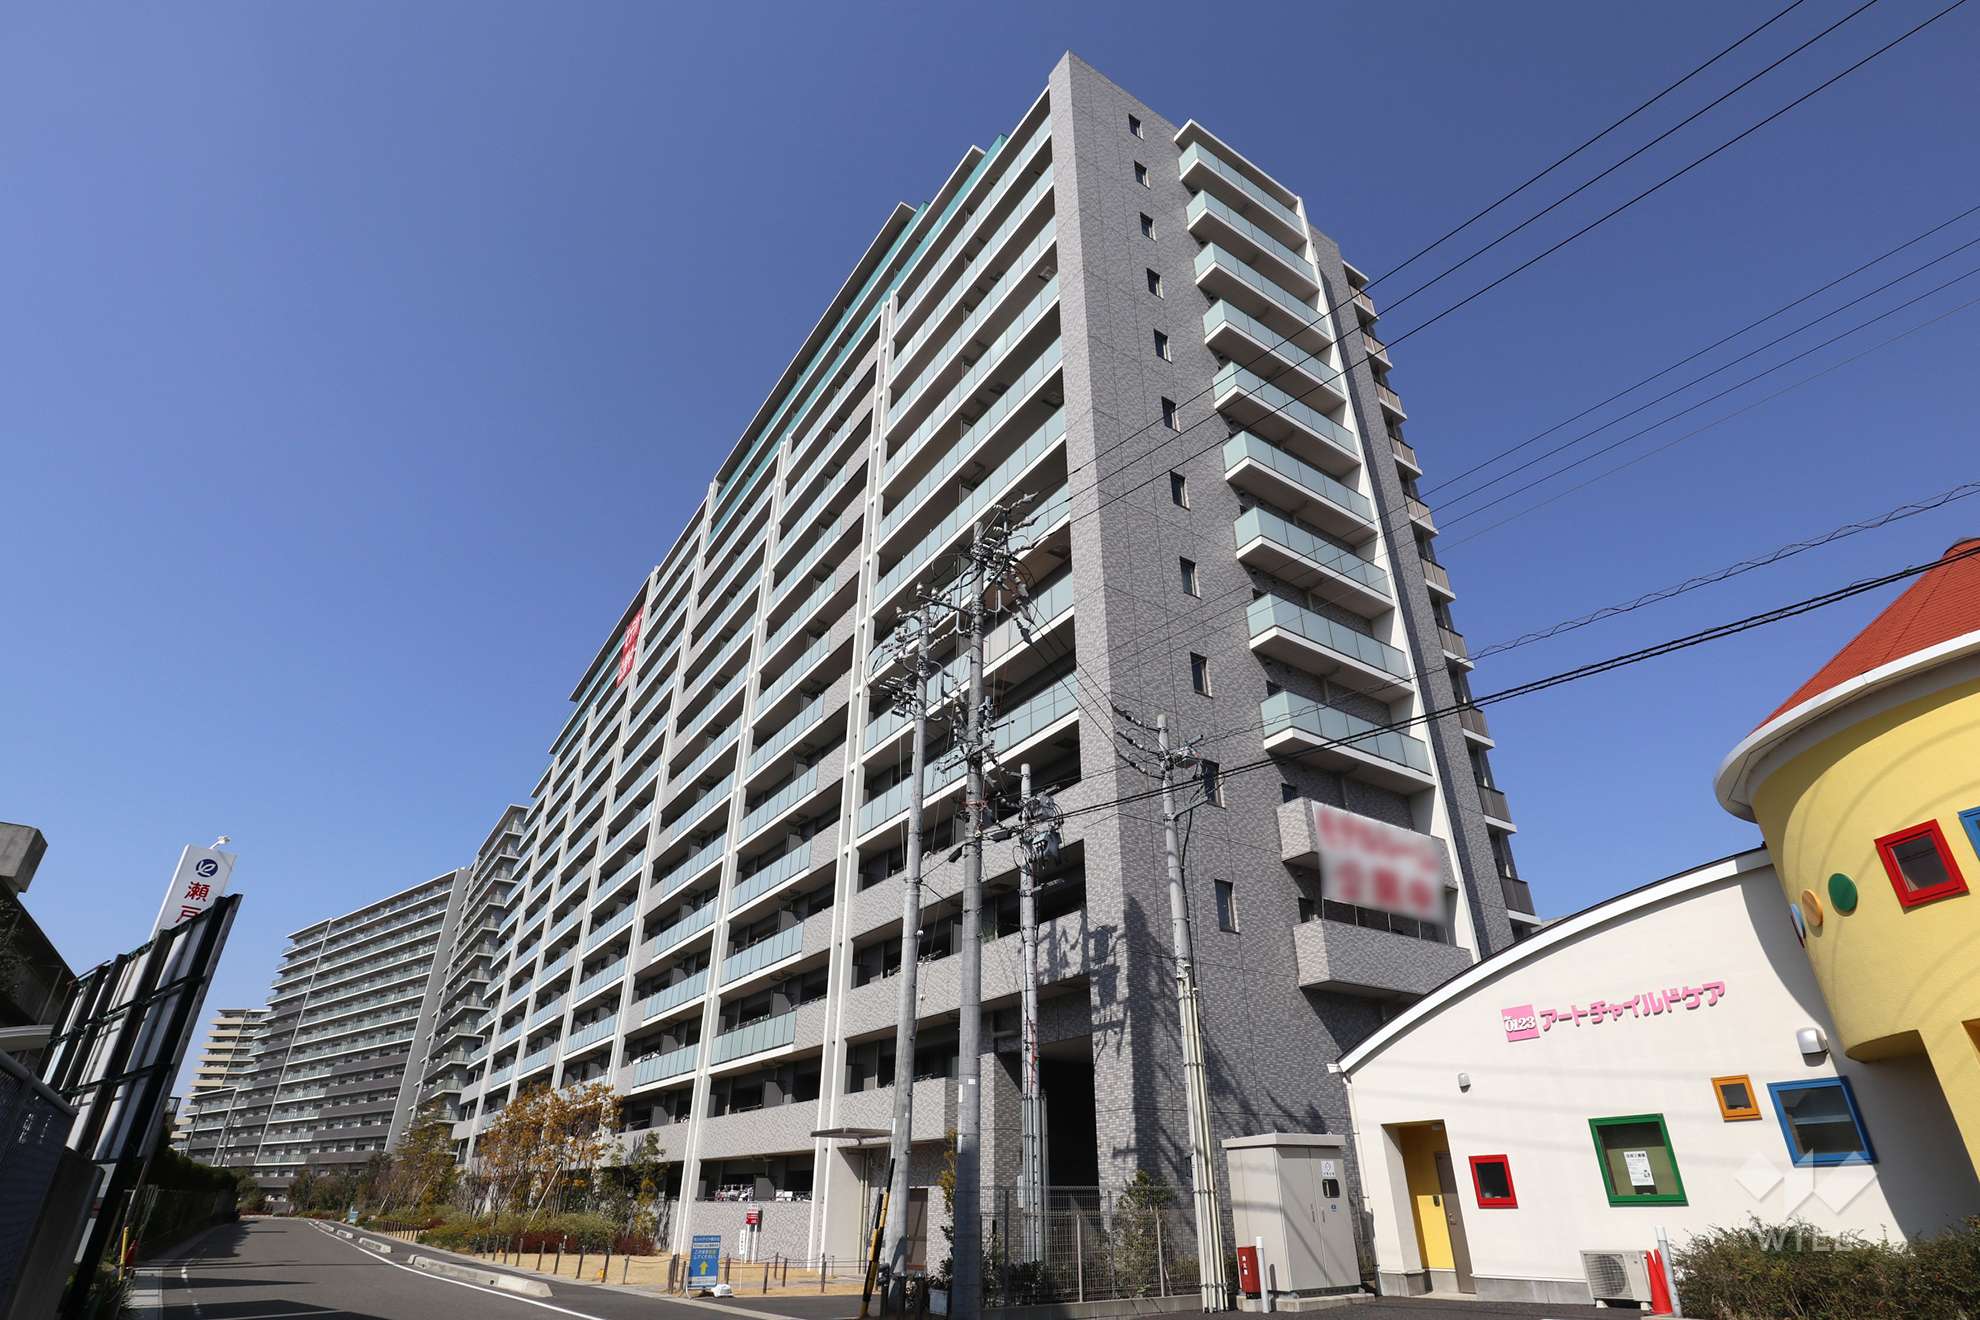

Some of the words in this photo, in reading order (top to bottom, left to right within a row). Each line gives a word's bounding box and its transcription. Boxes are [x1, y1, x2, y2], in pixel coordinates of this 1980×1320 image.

[1504, 1016, 1536, 1033] 0123
[1539, 981, 1726, 1032] アートチャイルドケア
